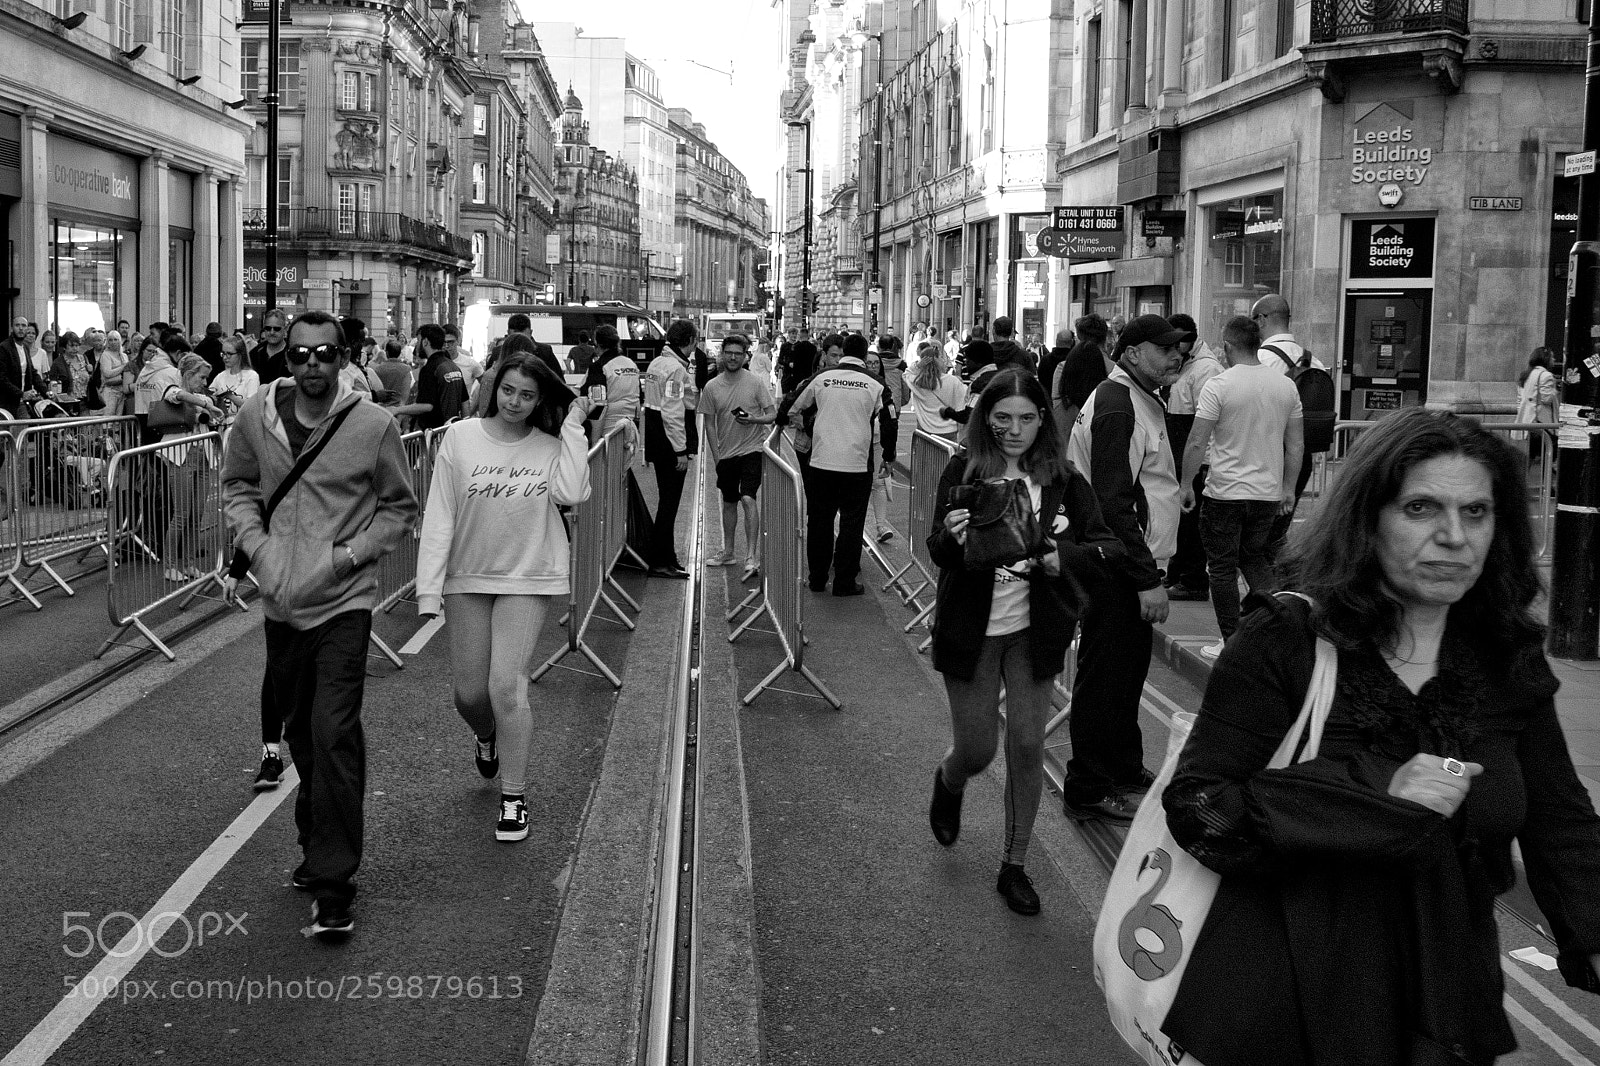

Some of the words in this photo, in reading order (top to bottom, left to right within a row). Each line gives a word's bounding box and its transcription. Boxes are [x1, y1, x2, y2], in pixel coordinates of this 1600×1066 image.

[1353, 126, 1412, 144] Leeds
[1352, 145, 1432, 165] Building
[1574, 154, 1593, 163] loading
[1351, 165, 1427, 185] Society
[112, 172, 131, 200] bank
[1381, 189, 1398, 197] swift
[1472, 199, 1488, 208] TIB
[1492, 199, 1520, 208] LANE
[1058, 209, 1079, 218] RETAIL
[1080, 209, 1095, 217] UNIT
[1096, 209, 1104, 217] TO
[1105, 209, 1117, 217] LET
[1058, 218, 1077, 229] 0161
[1079, 219, 1094, 229] 431
[1096, 218, 1117, 229] 0660
[1077, 237, 1099, 245] Hynes
[1370, 235, 1403, 245] Leeds
[1077, 245, 1116, 254] Illingworth
[1369, 246, 1414, 257] Building
[1368, 257, 1412, 268] Society
[350, 282, 360, 291] 68
[832, 379, 868, 389] SHOWSEC
[471, 465, 506, 477] LOVE
[509, 467, 544, 478] WILL
[467, 482, 521, 499] SAVE
[523, 481, 548, 497] US
